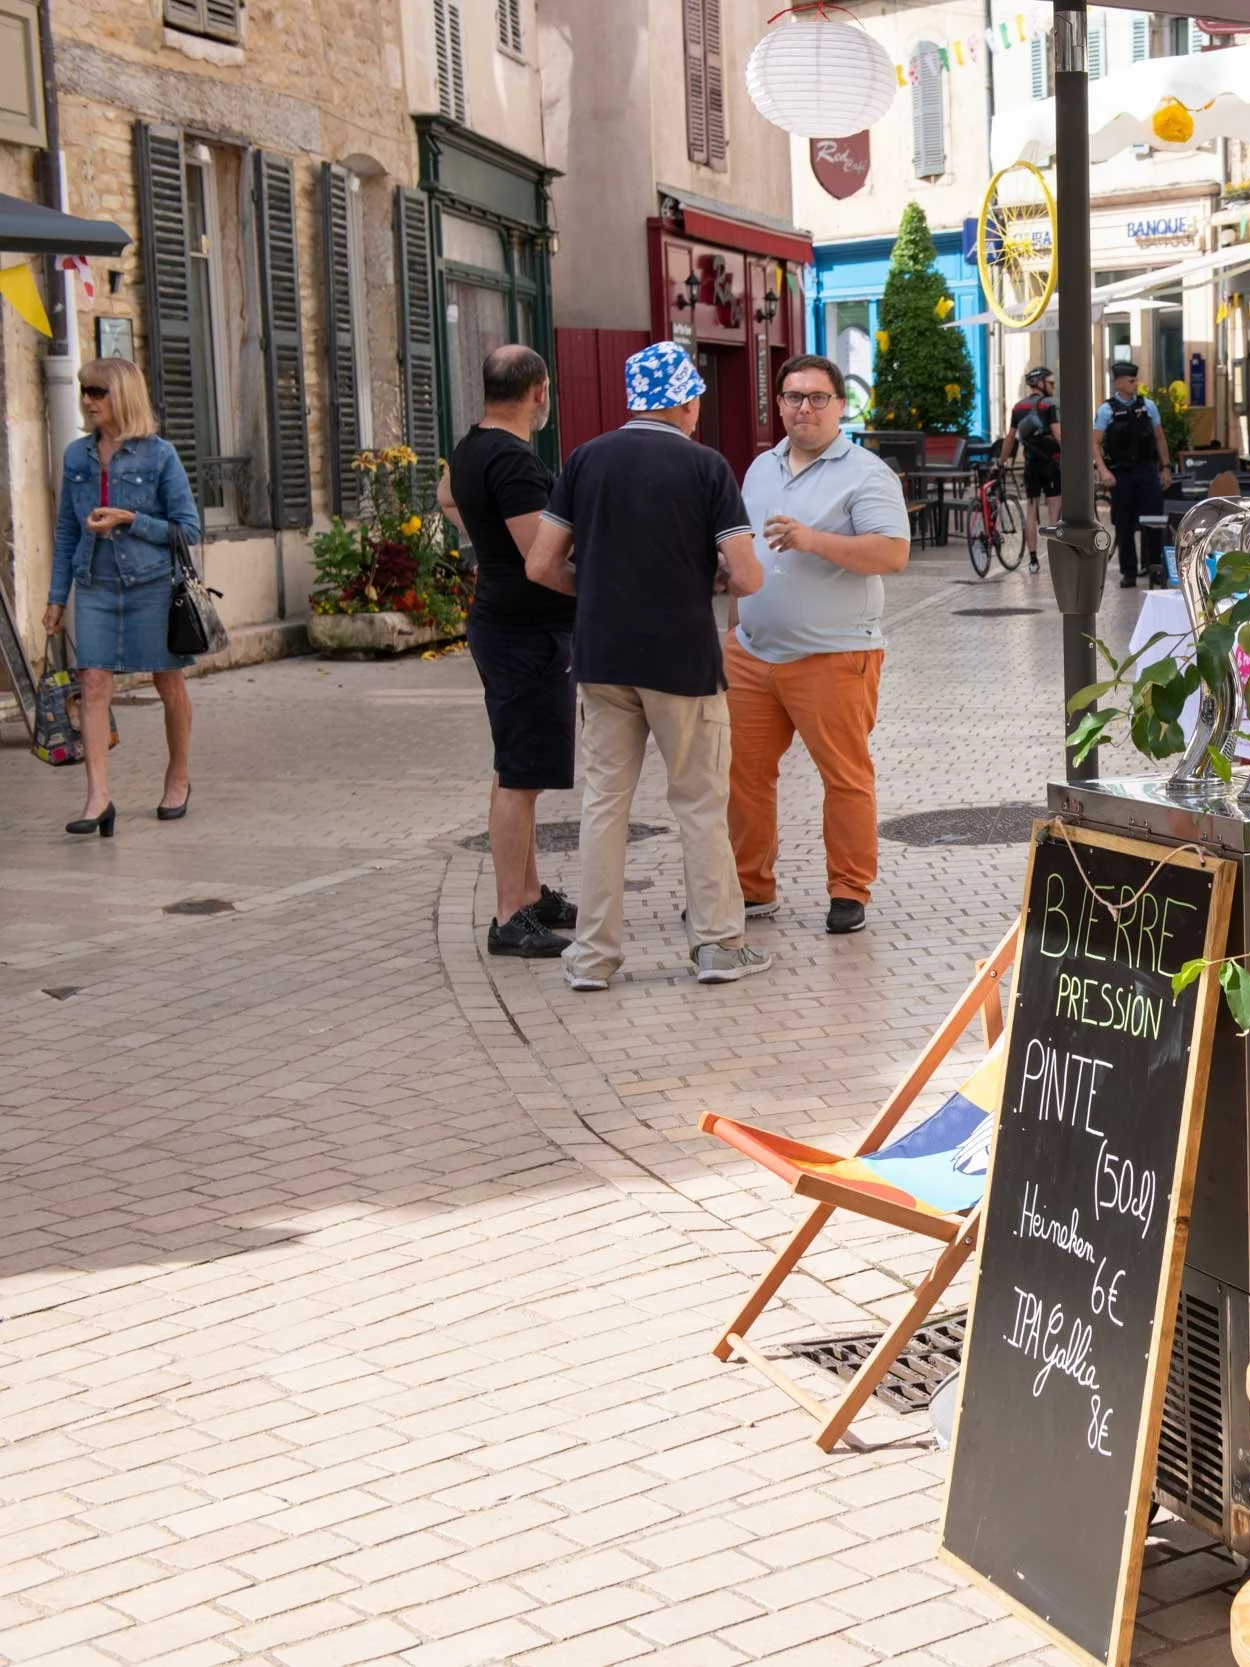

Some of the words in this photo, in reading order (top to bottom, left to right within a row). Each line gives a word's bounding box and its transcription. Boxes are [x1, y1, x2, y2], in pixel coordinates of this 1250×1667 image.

[815, 139, 850, 163] Red
[1127, 217, 1187, 237] BANQUE
[1040, 873, 1197, 978] BIERRE
[1091, 1256, 1126, 1327] 6€
[1087, 1395, 1114, 1457] 8€
